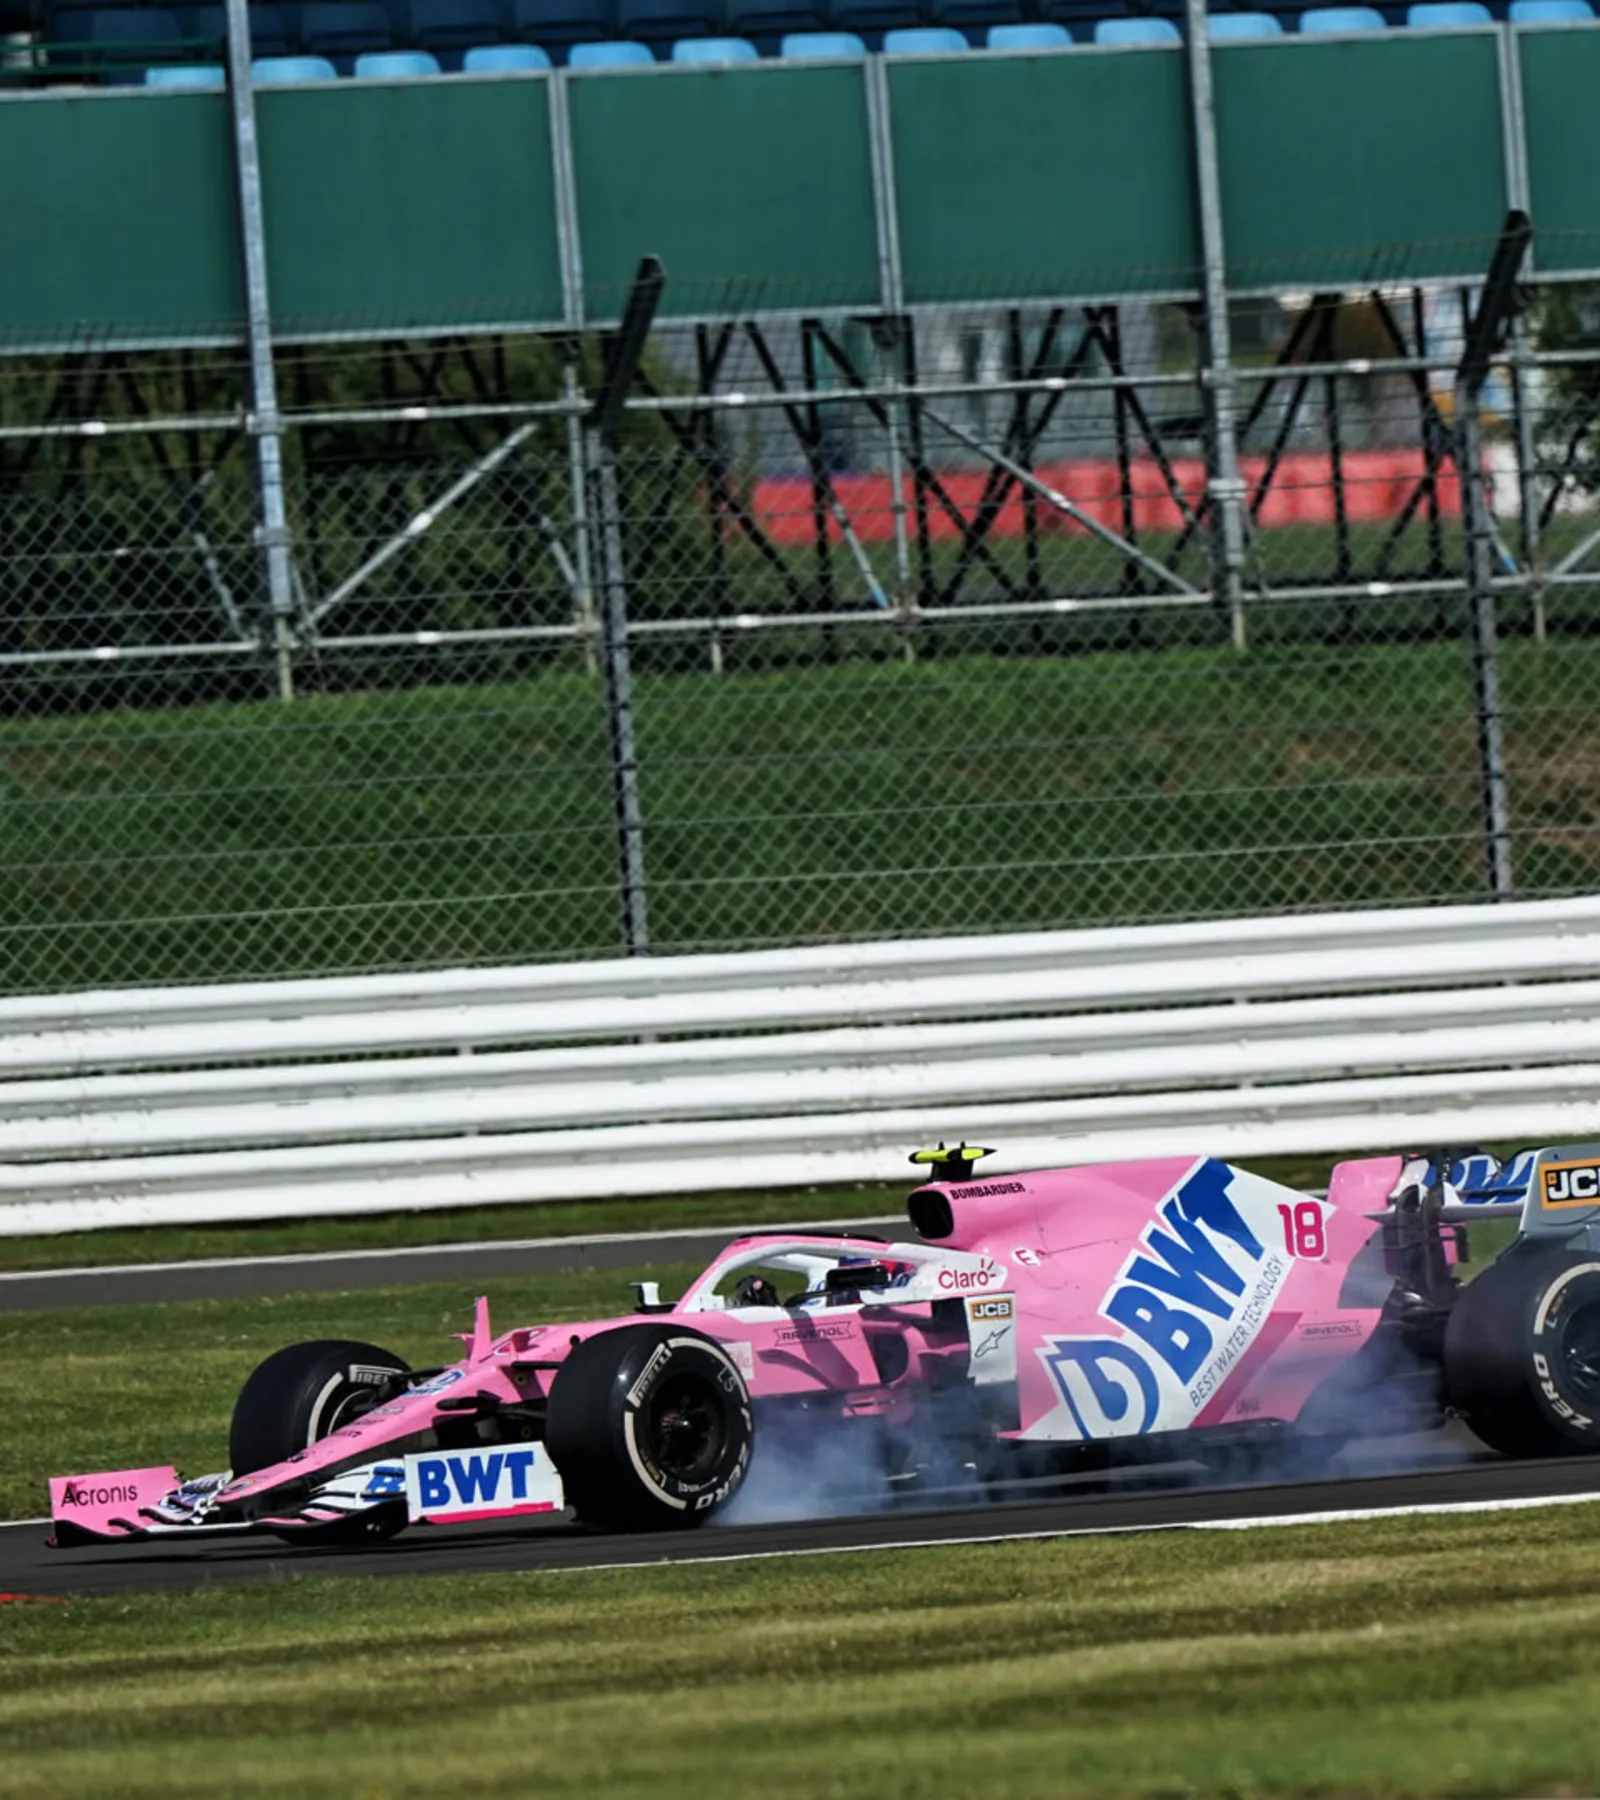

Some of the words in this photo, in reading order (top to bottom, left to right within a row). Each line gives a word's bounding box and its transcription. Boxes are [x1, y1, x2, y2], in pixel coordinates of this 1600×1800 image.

[950, 1182, 1026, 1200] BOMBARDIER
[1277, 1201, 1324, 1258] 18
[938, 1269, 989, 1289] Claro
[1105, 1157, 1265, 1387] BWT
[974, 1302, 1010, 1317] JCB
[1189, 1367, 1217, 1408] BEST
[1217, 1318, 1250, 1374] WATER
[1241, 1253, 1285, 1330] TECHNOLOGY
[1533, 1353, 1593, 1430] ZERO
[61, 1484, 138, 1507] Acronis
[417, 1451, 534, 1508] BWT
